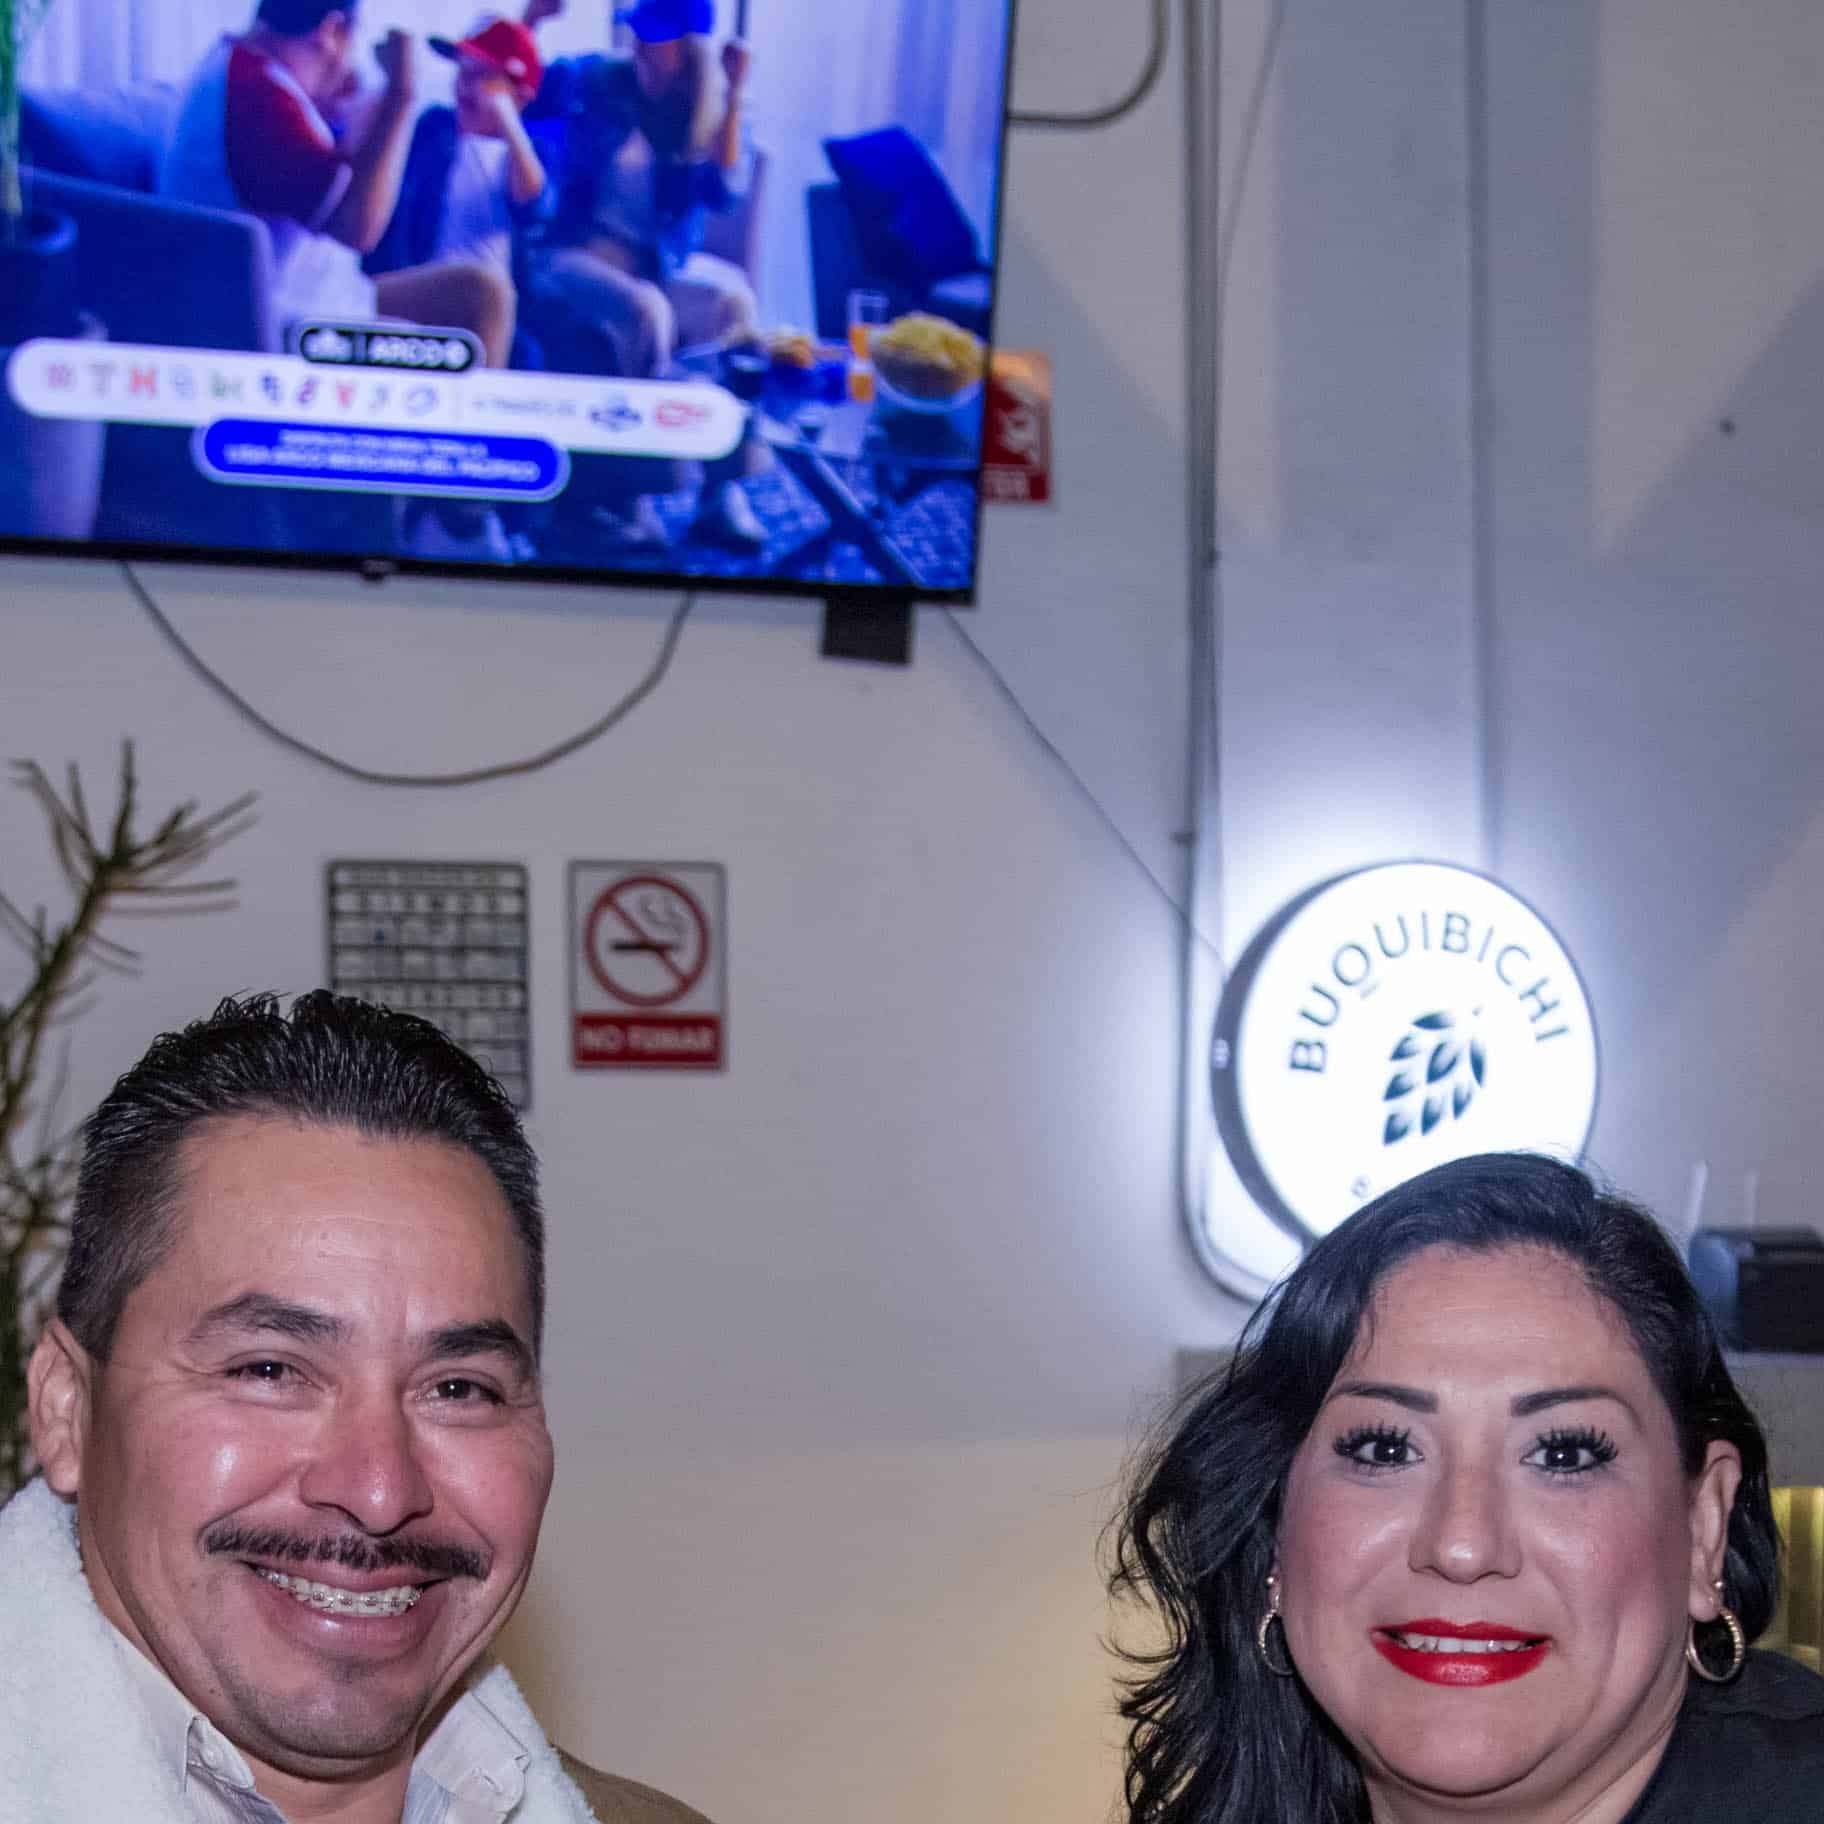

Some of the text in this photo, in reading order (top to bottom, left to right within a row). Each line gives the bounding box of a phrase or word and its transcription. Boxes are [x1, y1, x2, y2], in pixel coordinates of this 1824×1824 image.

[580, 1023, 715, 1054] NO FUMAR
[1289, 910, 1569, 1075] BUQUIBICHI
